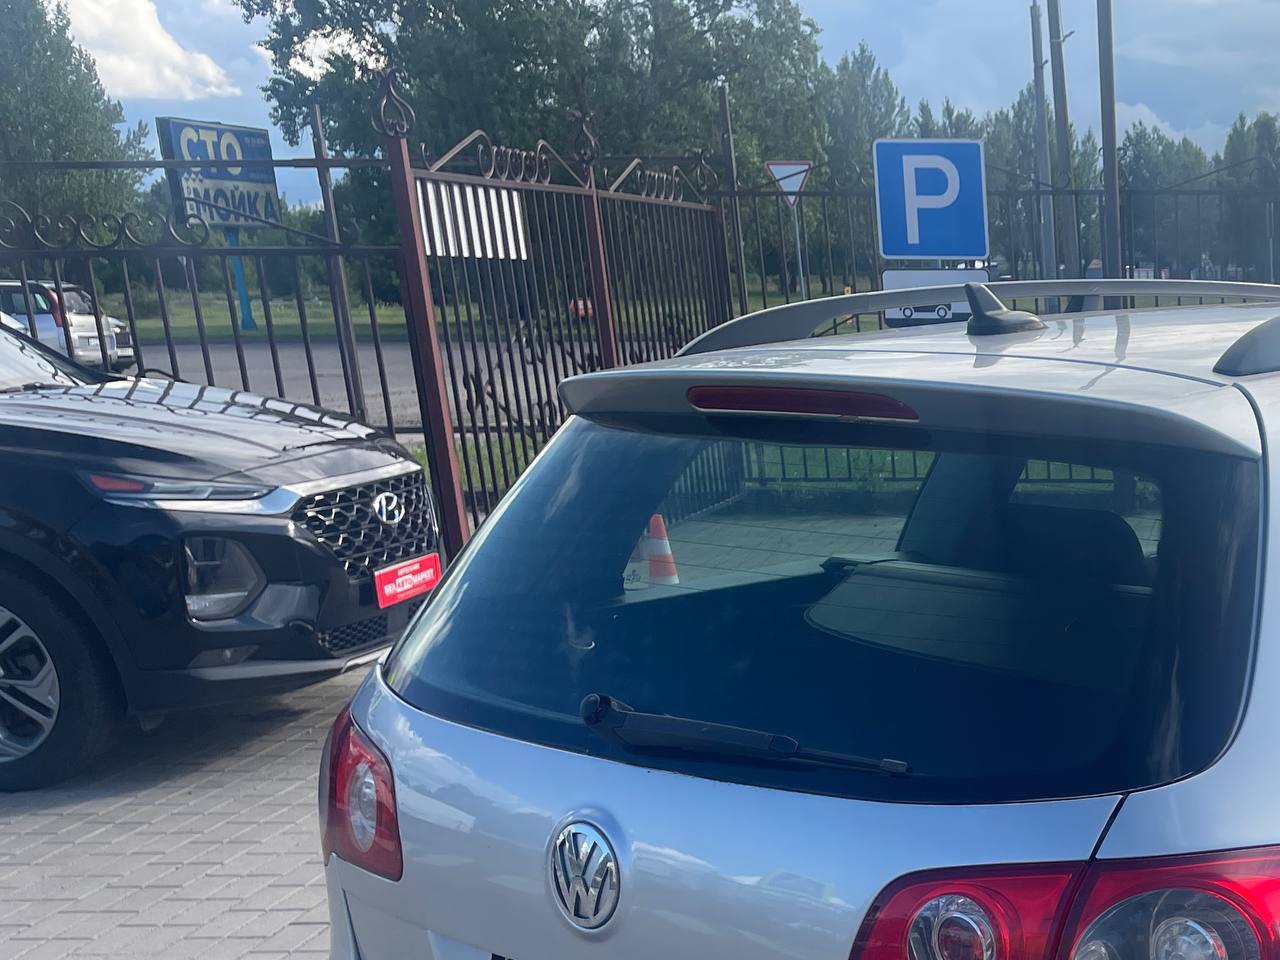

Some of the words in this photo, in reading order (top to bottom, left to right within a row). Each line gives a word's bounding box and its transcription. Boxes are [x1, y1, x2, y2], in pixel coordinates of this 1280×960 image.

[180, 126, 243, 176] СТО
[193, 184, 281, 224] МОЙКА
[902, 154, 961, 245] P
